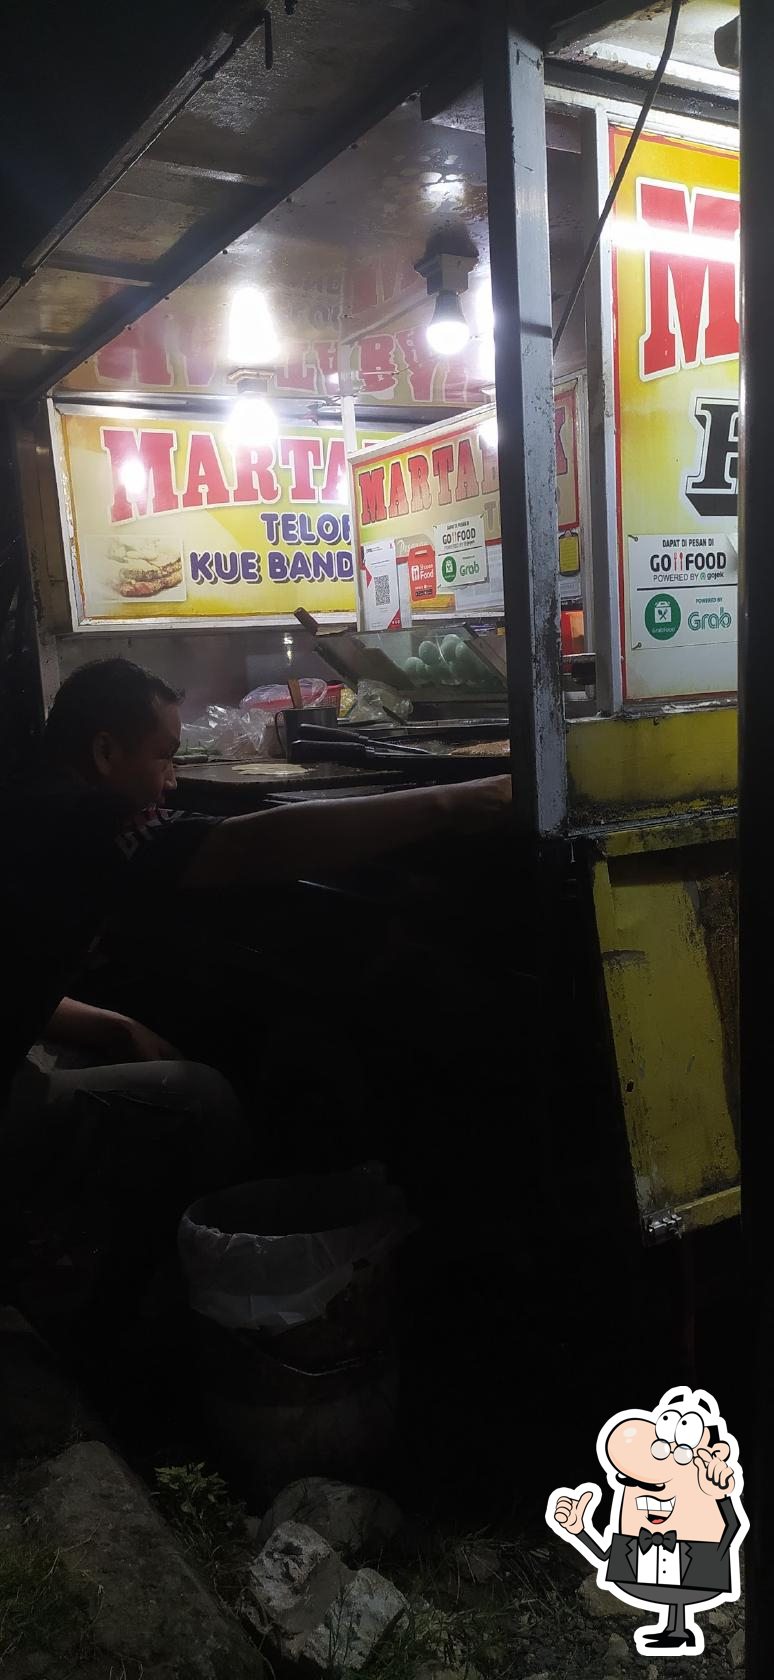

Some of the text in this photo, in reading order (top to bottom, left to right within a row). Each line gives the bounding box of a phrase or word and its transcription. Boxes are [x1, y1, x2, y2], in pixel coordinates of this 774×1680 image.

[457, 528, 476, 543] FOOD
[662, 538, 714, 548] DAPAT DI PESAN DI
[190, 551, 263, 584] KUE
[460, 560, 480, 577] Grab
[650, 552, 727, 572] GO FOOD
[653, 571, 724, 582] POWERED BY gojek
[687, 607, 732, 631] Grab
